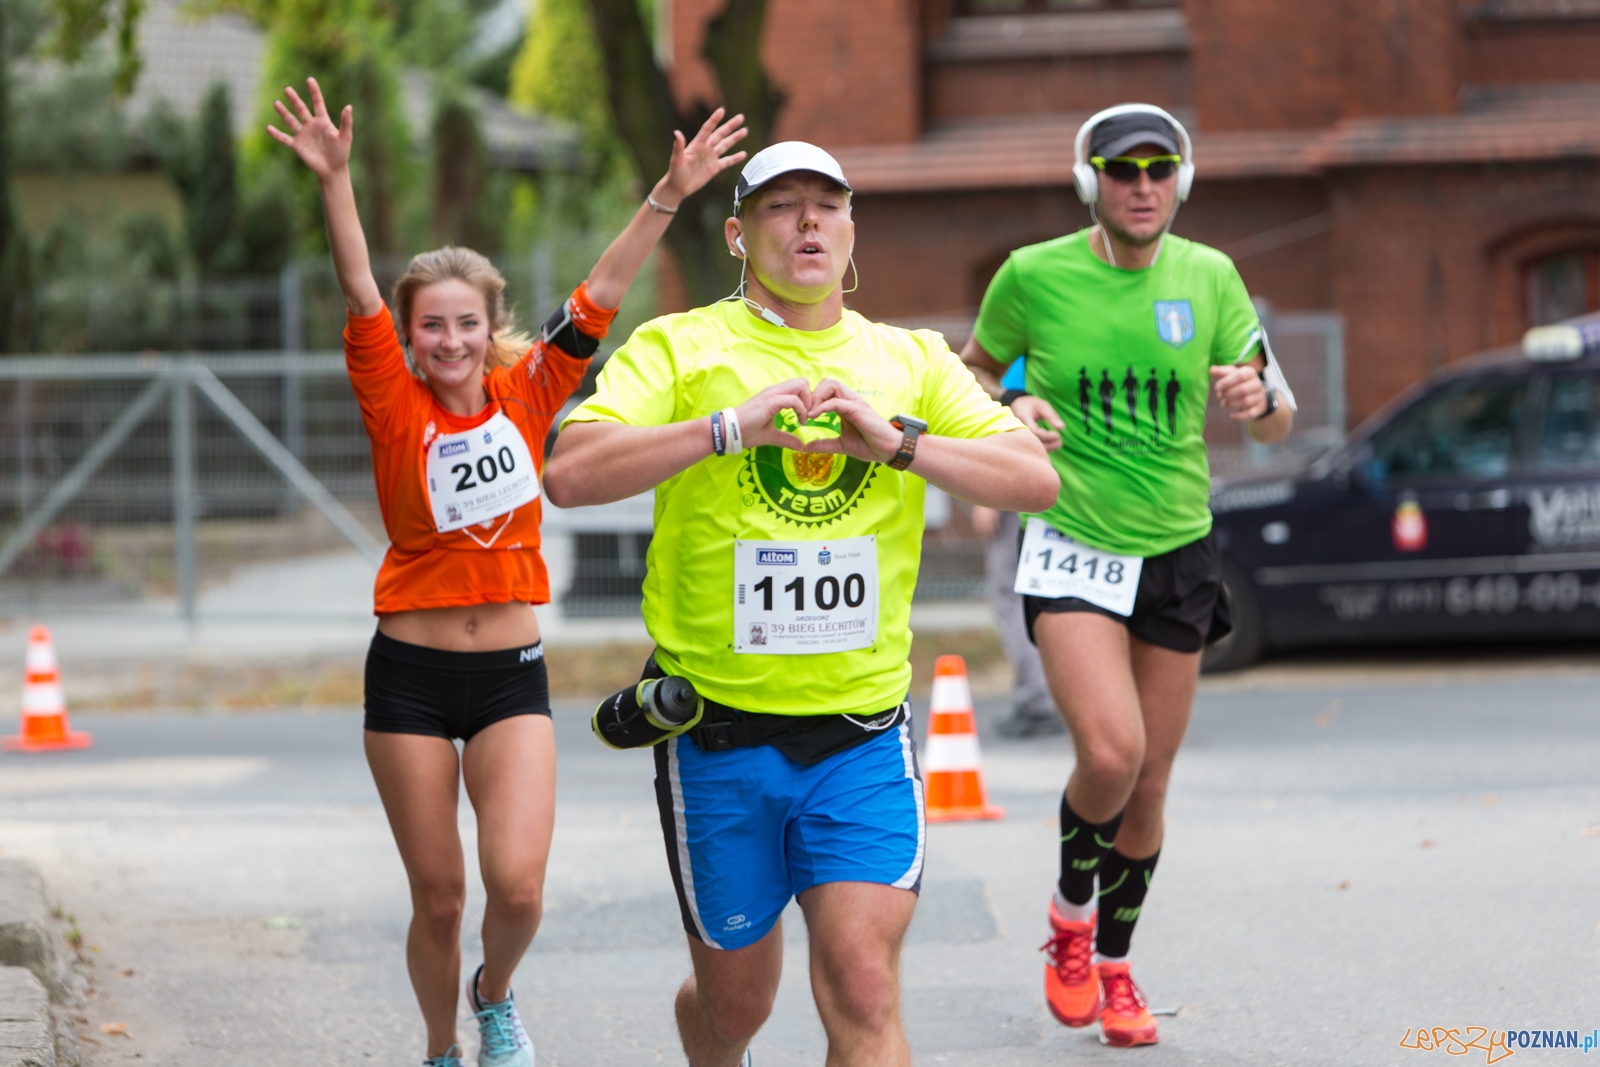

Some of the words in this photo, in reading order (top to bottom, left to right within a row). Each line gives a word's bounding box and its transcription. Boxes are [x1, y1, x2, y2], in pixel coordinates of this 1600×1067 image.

[451, 446, 515, 492] 200
[476, 490, 497, 504] BIEG
[1038, 548, 1125, 584] 1418
[754, 573, 865, 611] 1100
[770, 623, 785, 633] 39
[788, 622, 815, 633] BIEG
[818, 617, 867, 632] LECHITÓW
